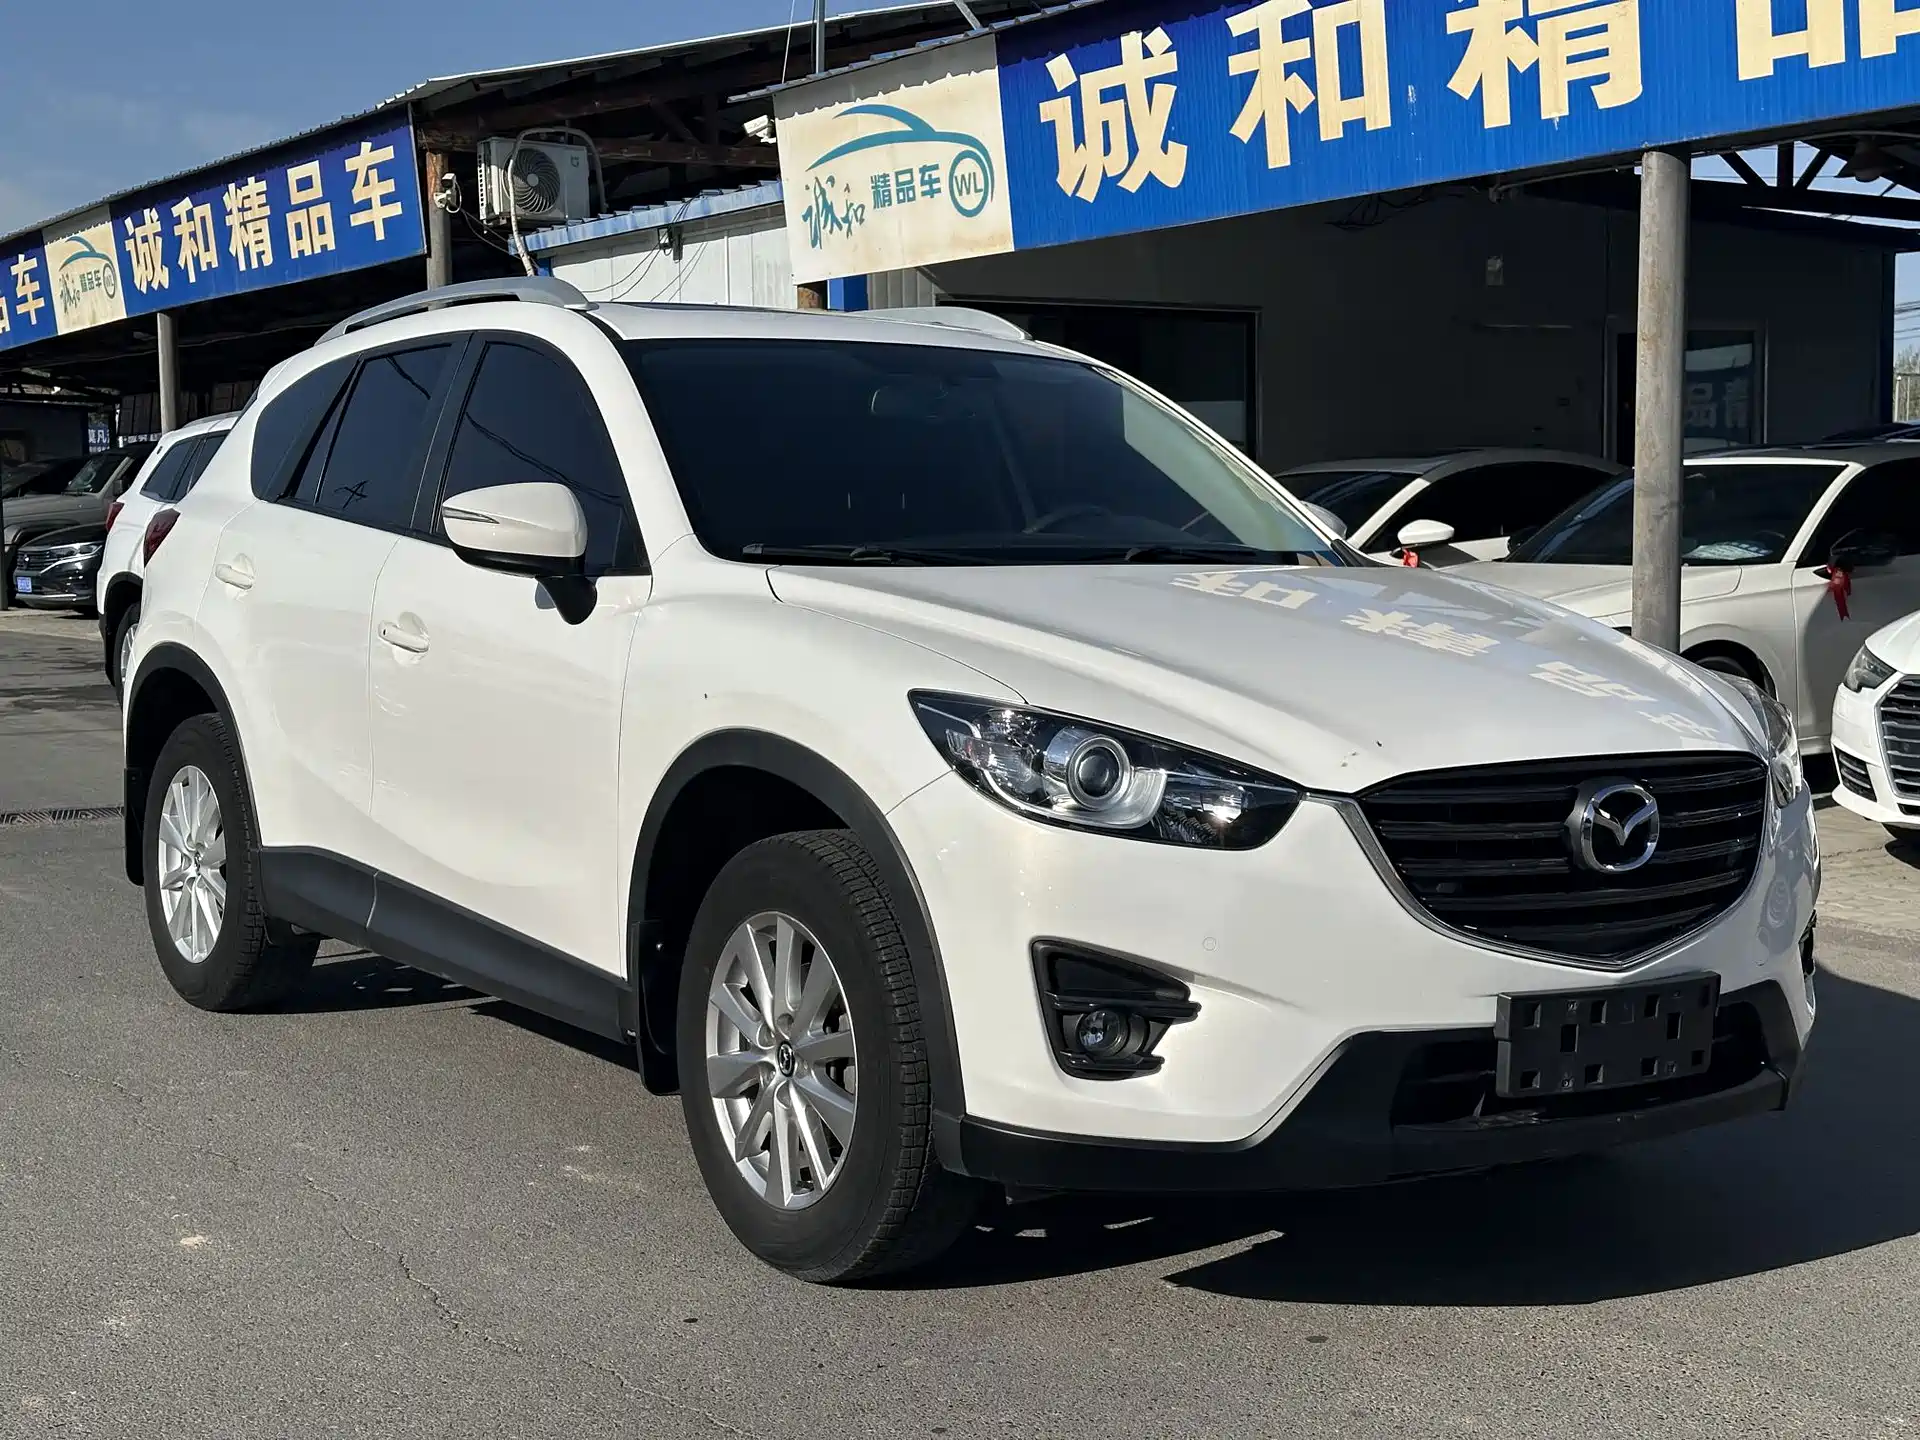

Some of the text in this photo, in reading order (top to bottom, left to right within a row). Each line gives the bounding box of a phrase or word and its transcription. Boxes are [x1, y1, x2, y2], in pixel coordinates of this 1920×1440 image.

[870, 163, 942, 209] 精品车
[954, 171, 983, 197] WL
[125, 141, 402, 294] 诚和精品车
[0, 254, 45, 334] 车
